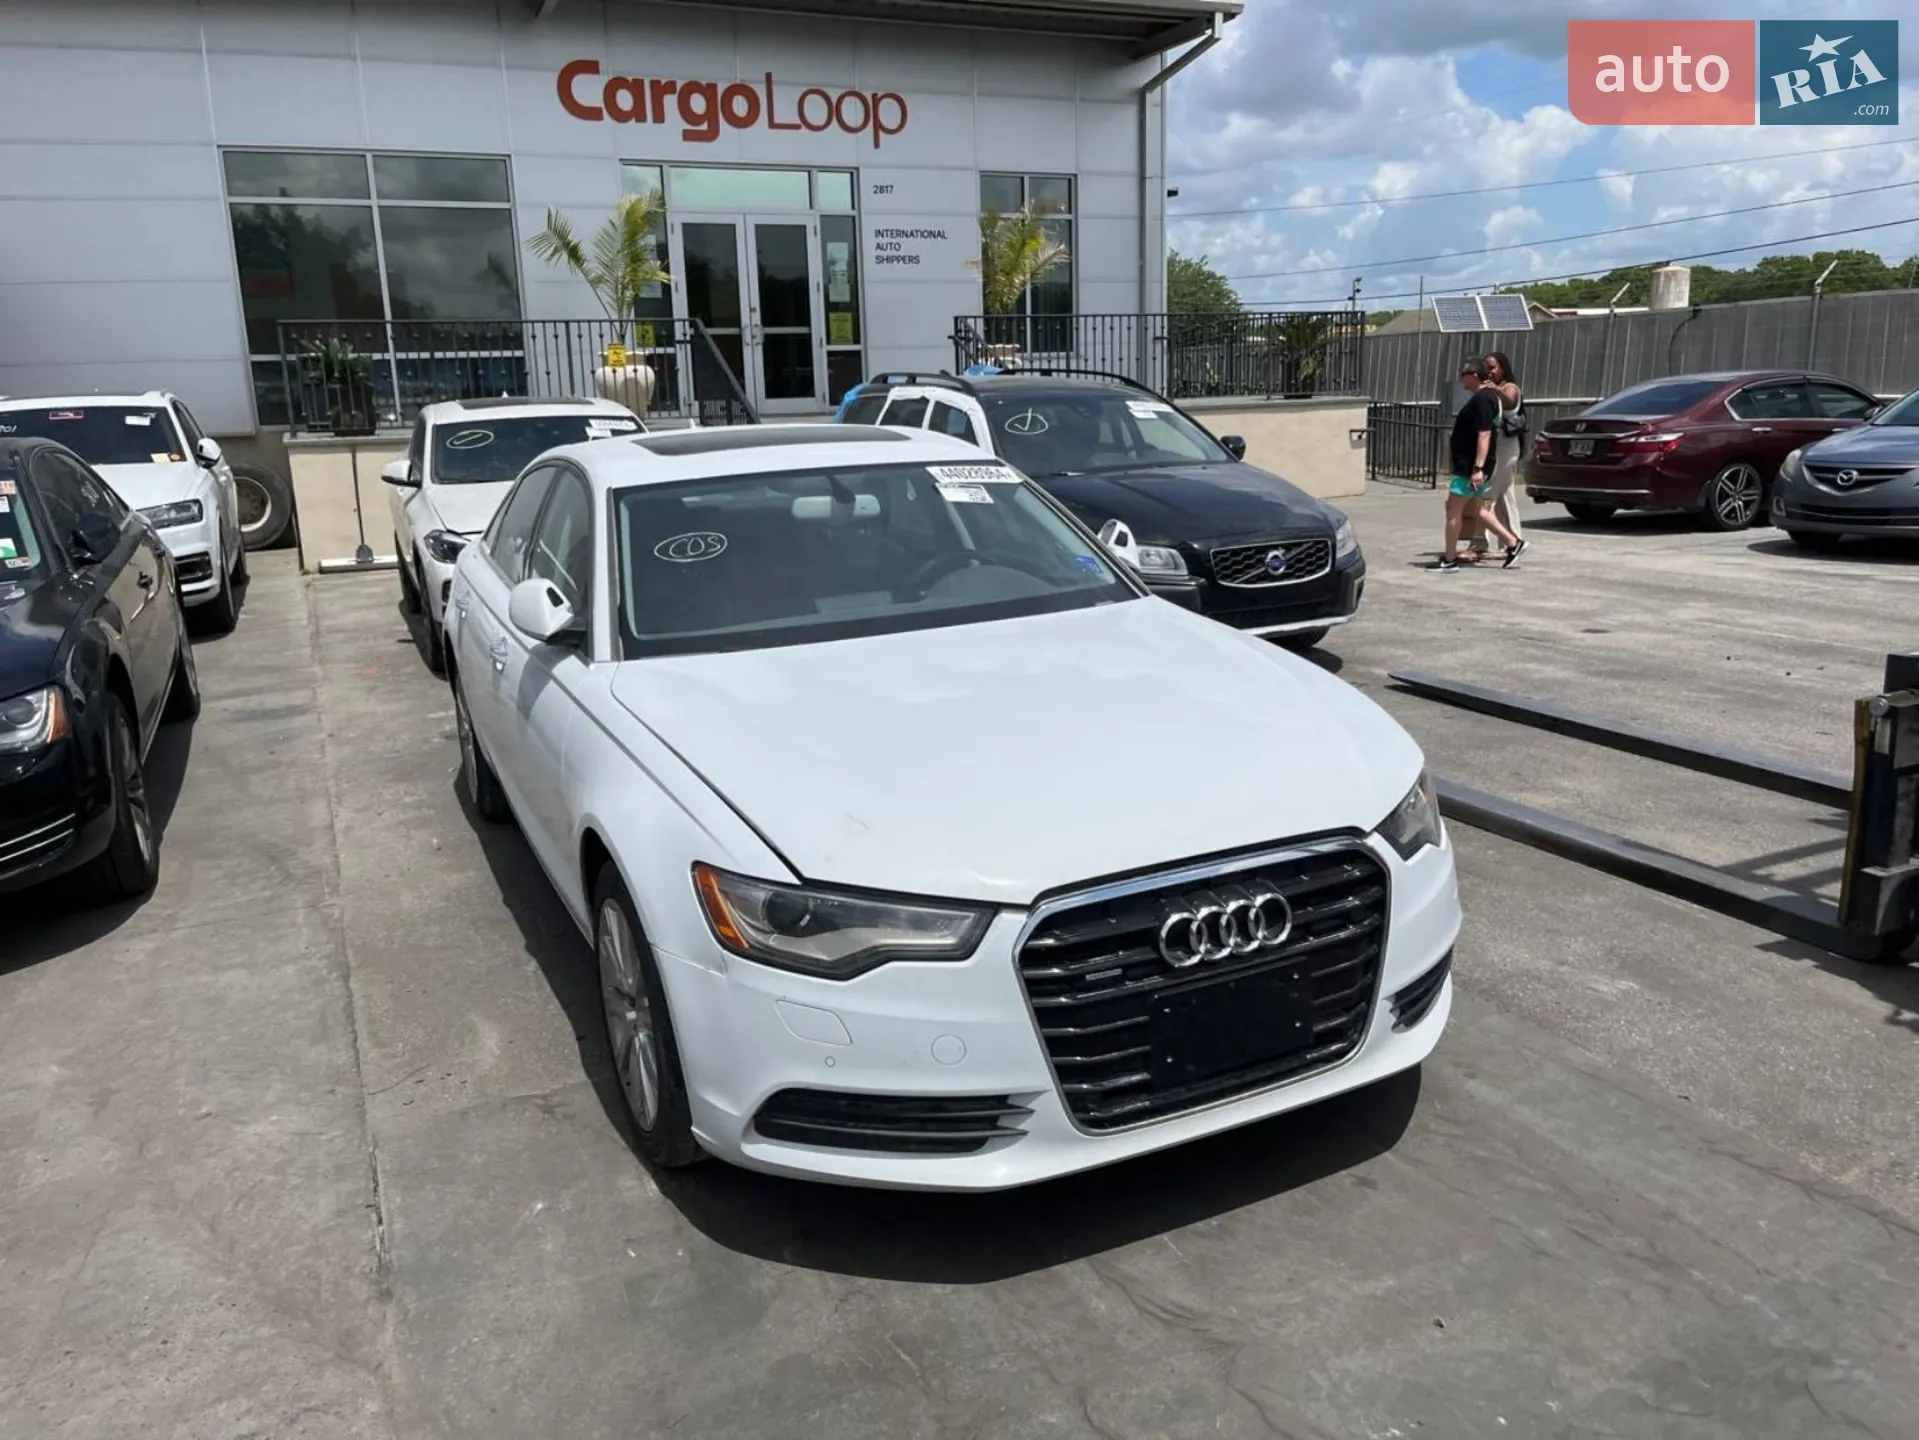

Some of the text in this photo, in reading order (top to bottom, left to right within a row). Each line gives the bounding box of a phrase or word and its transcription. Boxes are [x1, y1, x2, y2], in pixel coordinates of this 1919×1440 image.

[872, 184, 894, 194] 2817
[874, 229, 948, 239] INTERNATIONAL
[875, 242, 902, 252] AUTO
[875, 255, 920, 265] SHIPPERS
